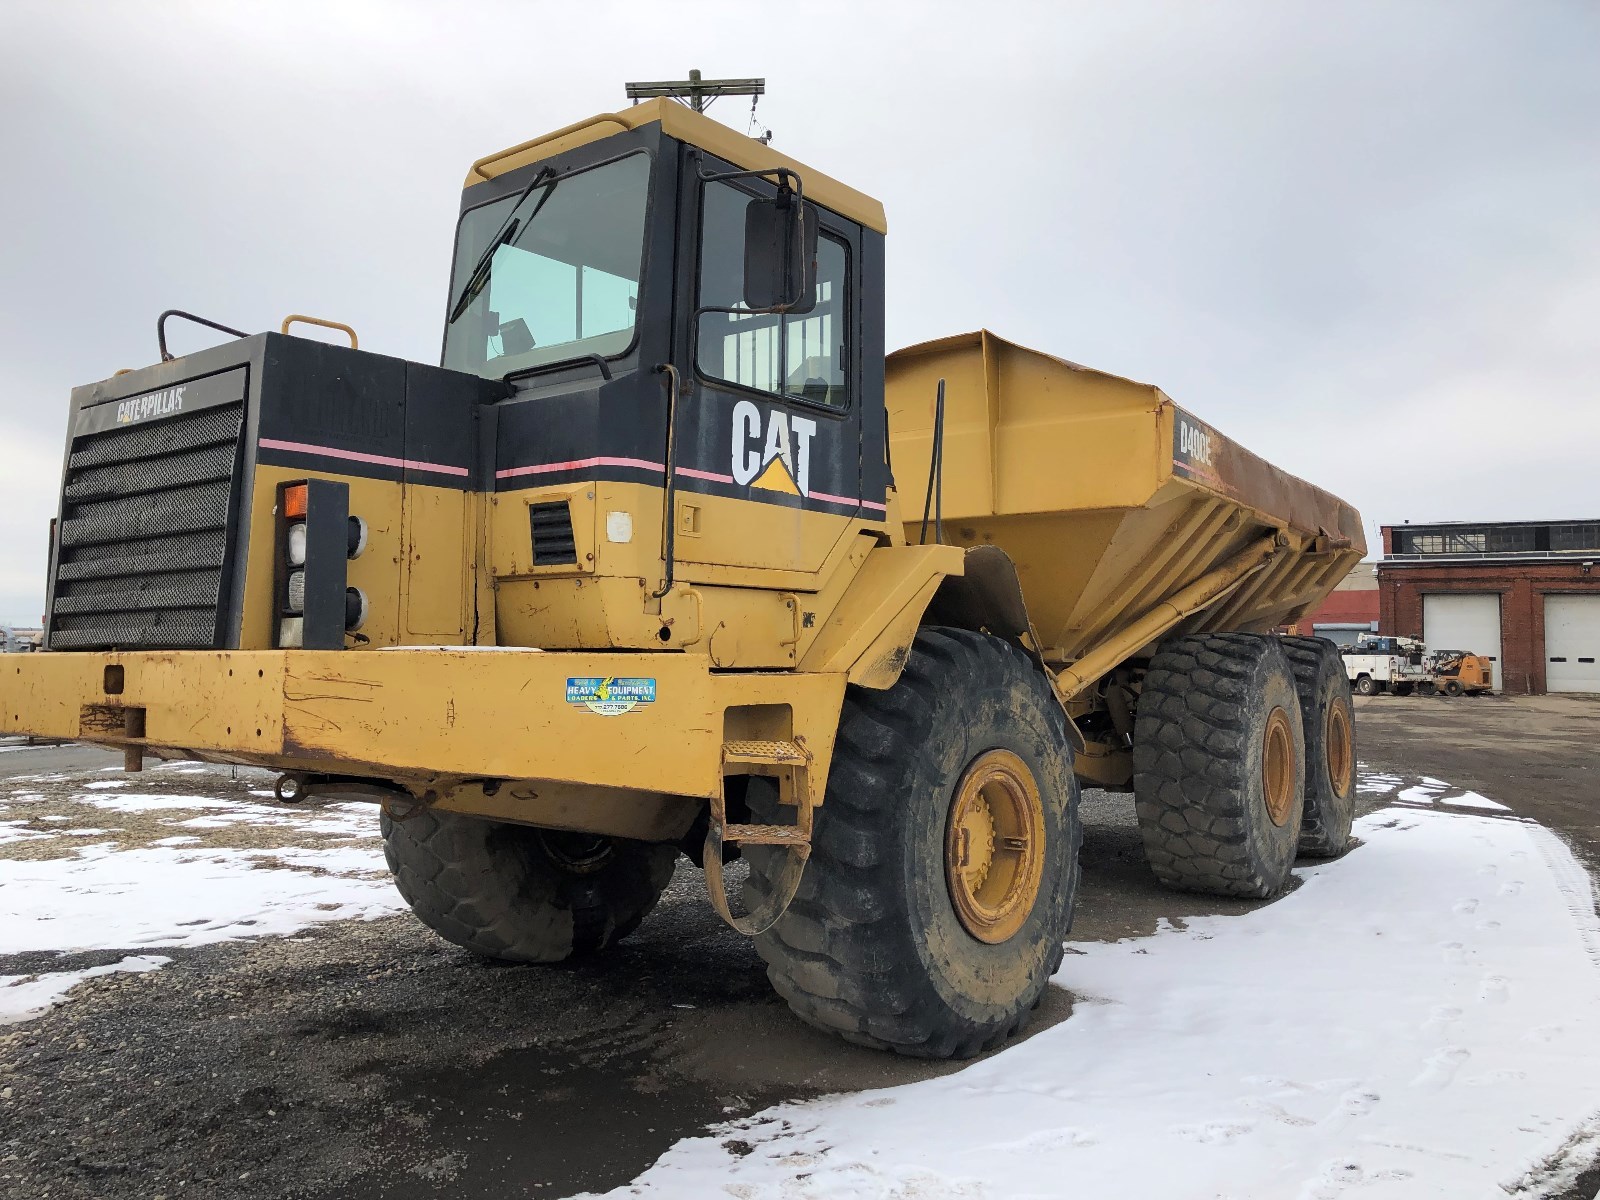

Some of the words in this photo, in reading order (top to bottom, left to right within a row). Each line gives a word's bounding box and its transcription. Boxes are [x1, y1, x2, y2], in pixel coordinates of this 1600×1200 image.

[116, 386, 184, 423] CATERPILLAR
[731, 400, 817, 498] CAT
[1180, 420, 1212, 467] D400E
[567, 686, 597, 695] HEAVY
